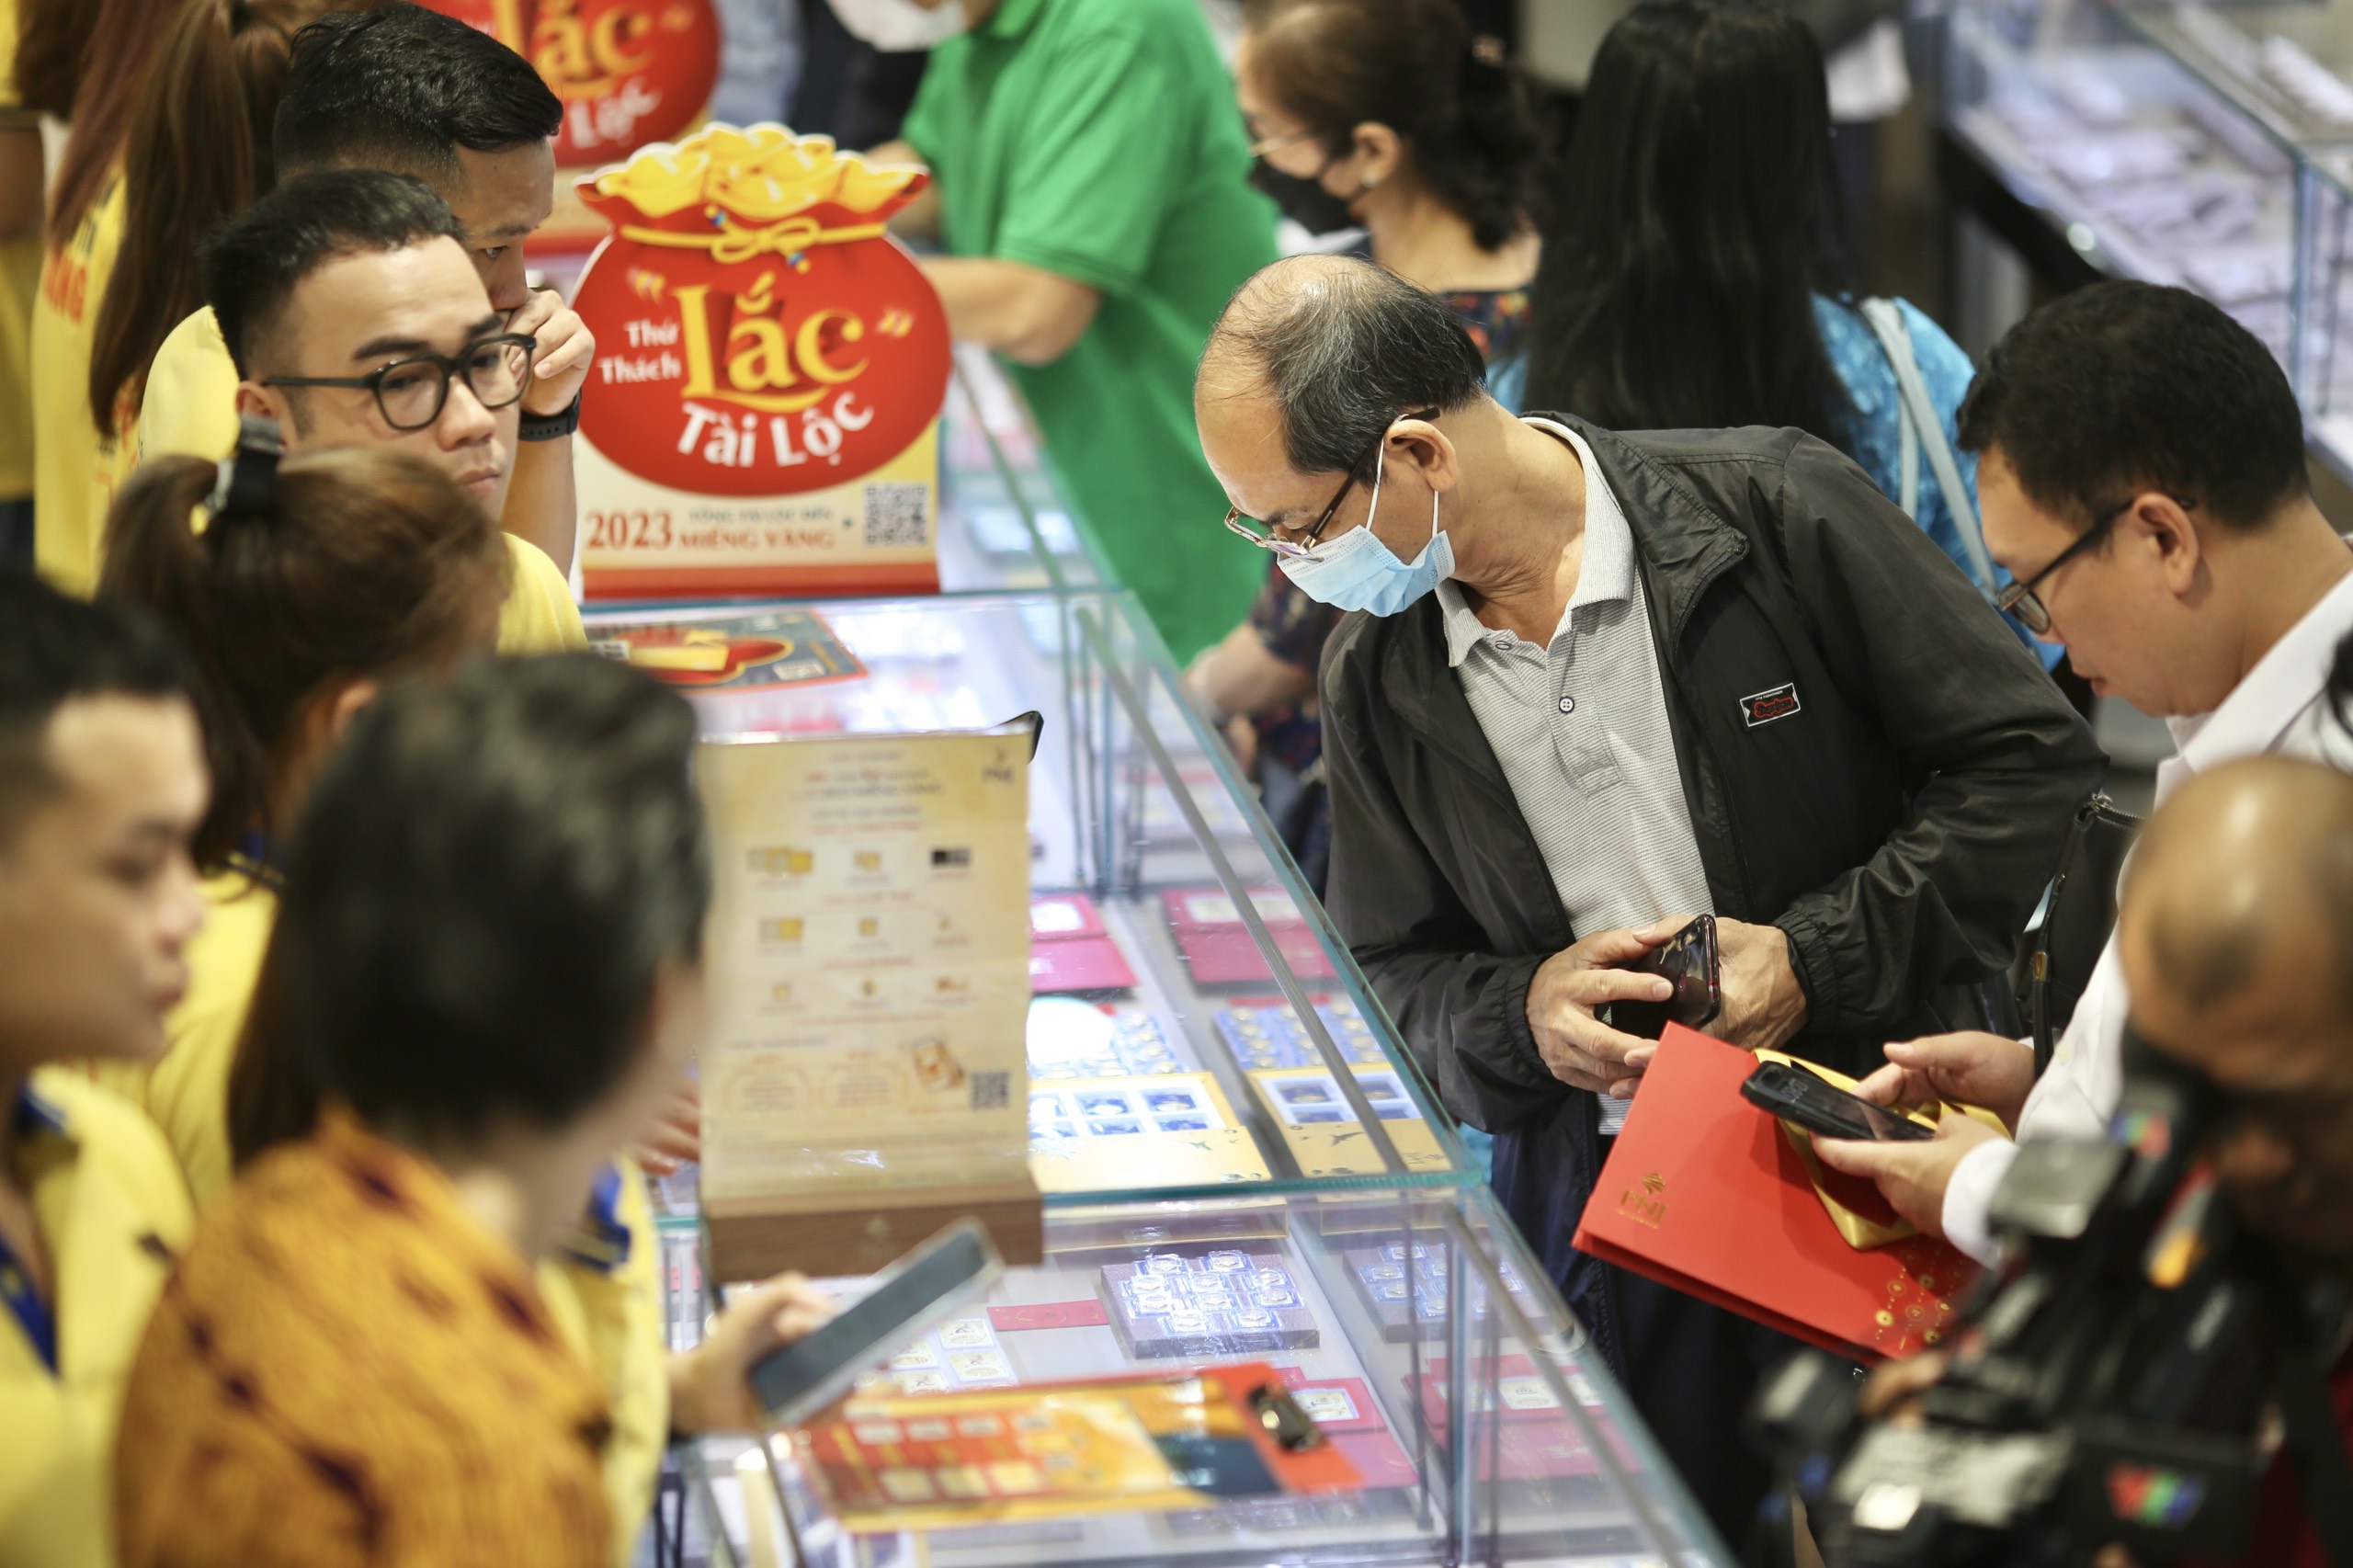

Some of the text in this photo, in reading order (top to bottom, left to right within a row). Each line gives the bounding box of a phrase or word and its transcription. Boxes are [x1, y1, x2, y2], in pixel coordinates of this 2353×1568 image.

[625, 319, 680, 347] Thử
[597, 353, 681, 384] Thách
[677, 391, 874, 469] Tài Lộc
[586, 509, 675, 550] 2023
